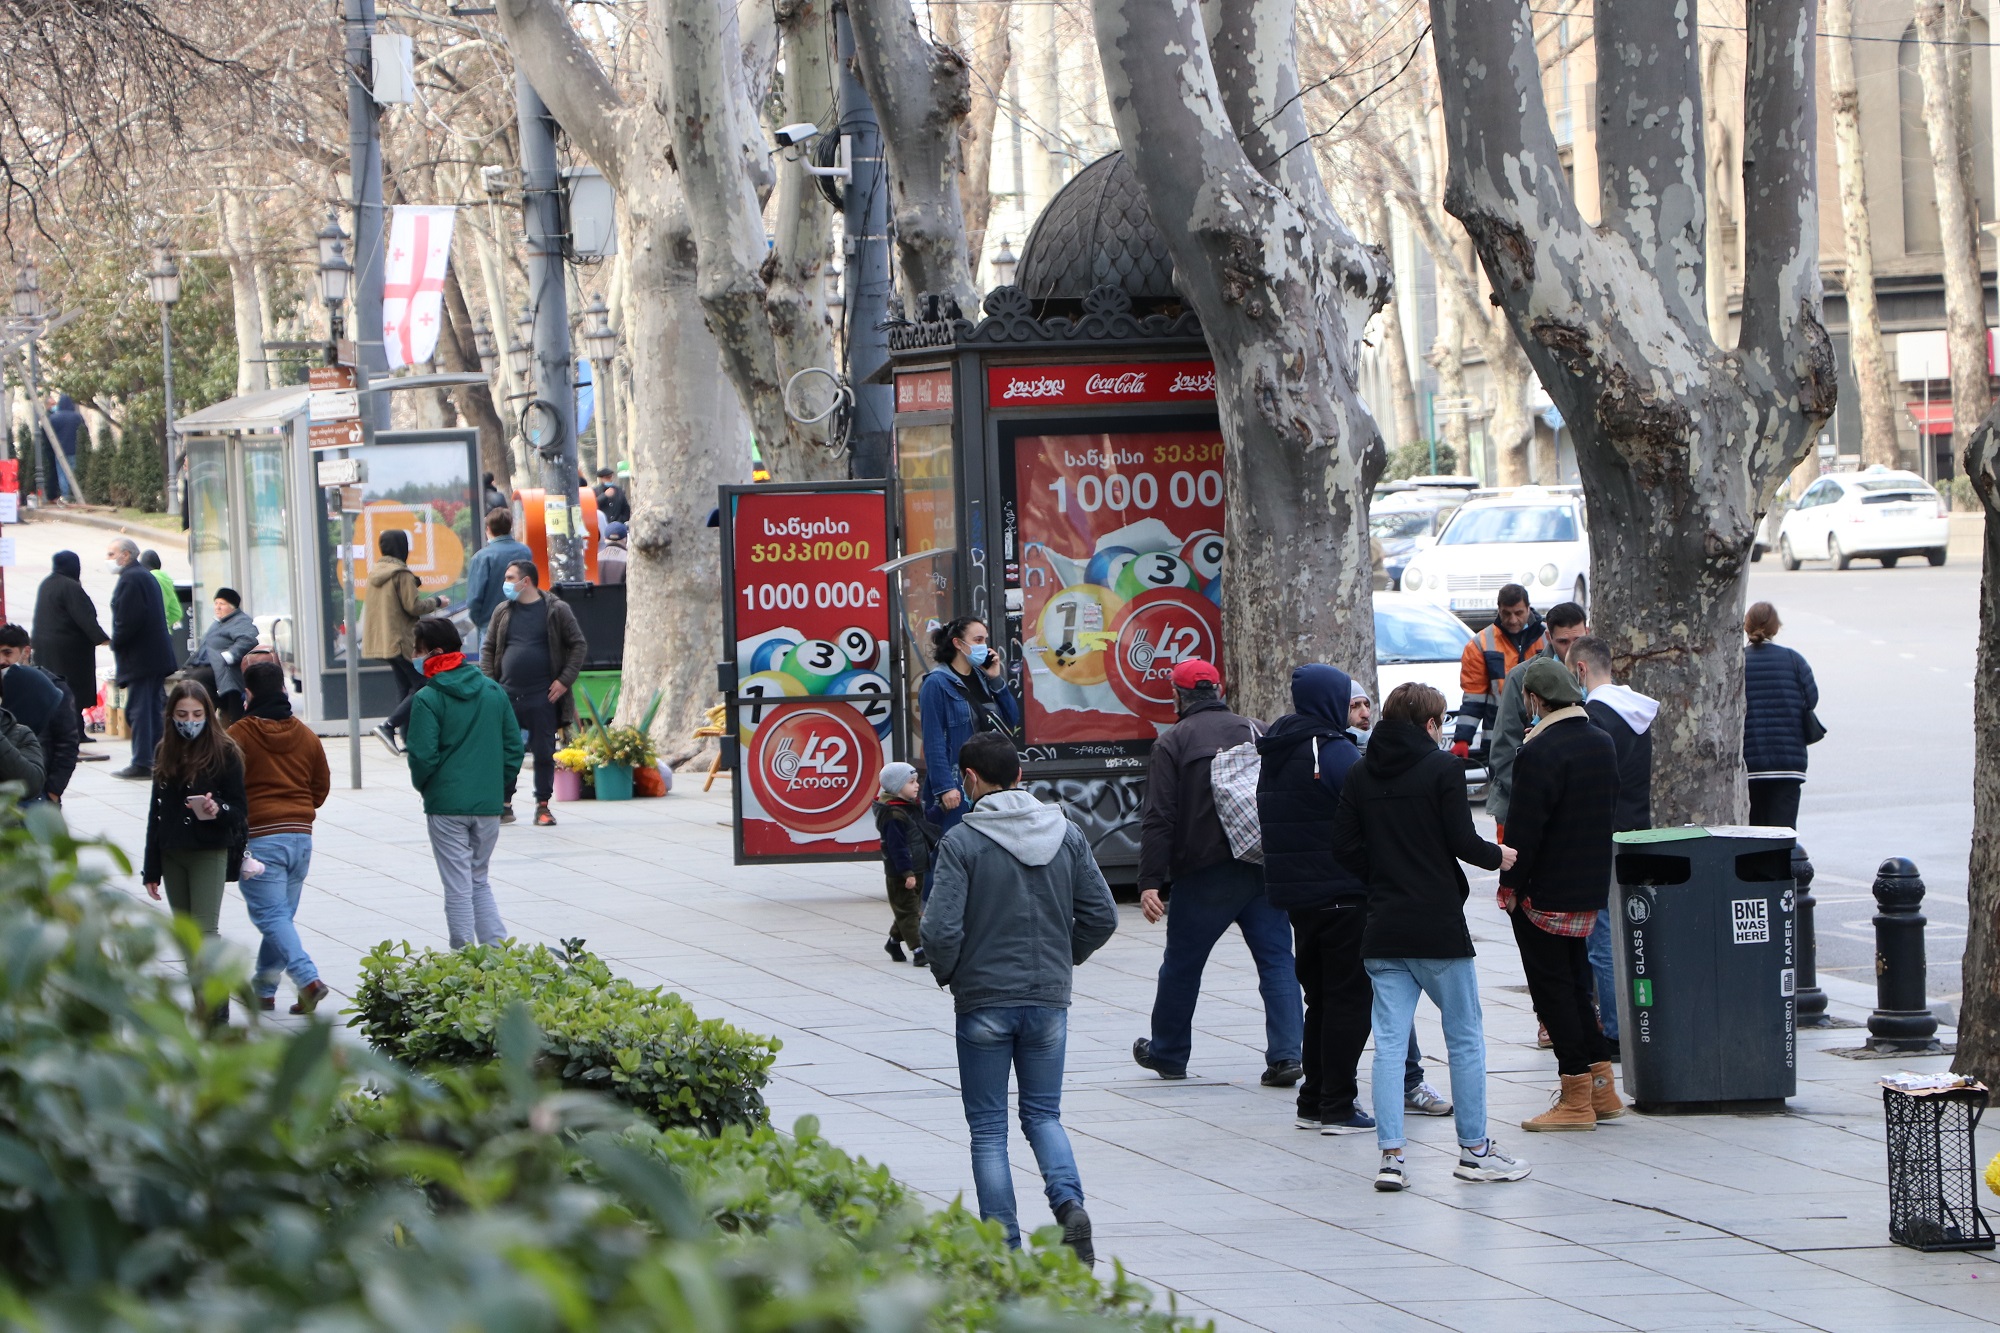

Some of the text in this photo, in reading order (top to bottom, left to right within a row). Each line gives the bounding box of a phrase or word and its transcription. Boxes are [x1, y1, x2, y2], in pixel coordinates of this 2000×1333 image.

[1085, 372, 1147, 395] Coca-Cola
[1064, 443, 1225, 470] საწყისი ჯეკპო
[1170, 470, 1224, 508] 00
[764, 517, 849, 539] საწყისი
[751, 540, 870, 562] ჯეკპოტი
[1148, 554, 1177, 584] 3
[809, 643, 834, 668] 3
[847, 632, 867, 656] 9
[746, 685, 764, 723] 1
[858, 682, 887, 717] 2
[791, 777, 848, 790] ლოტო
[1735, 902, 1765, 919] BNE
[1736, 920, 1766, 930] WAS
[1736, 931, 1767, 941] HERE
[1634, 930, 1645, 974] GLASS
[1785, 919, 1793, 965] PAPER
[1640, 1011, 1651, 1043] მინა
[1785, 1002, 1793, 1068] ქაღალდი
